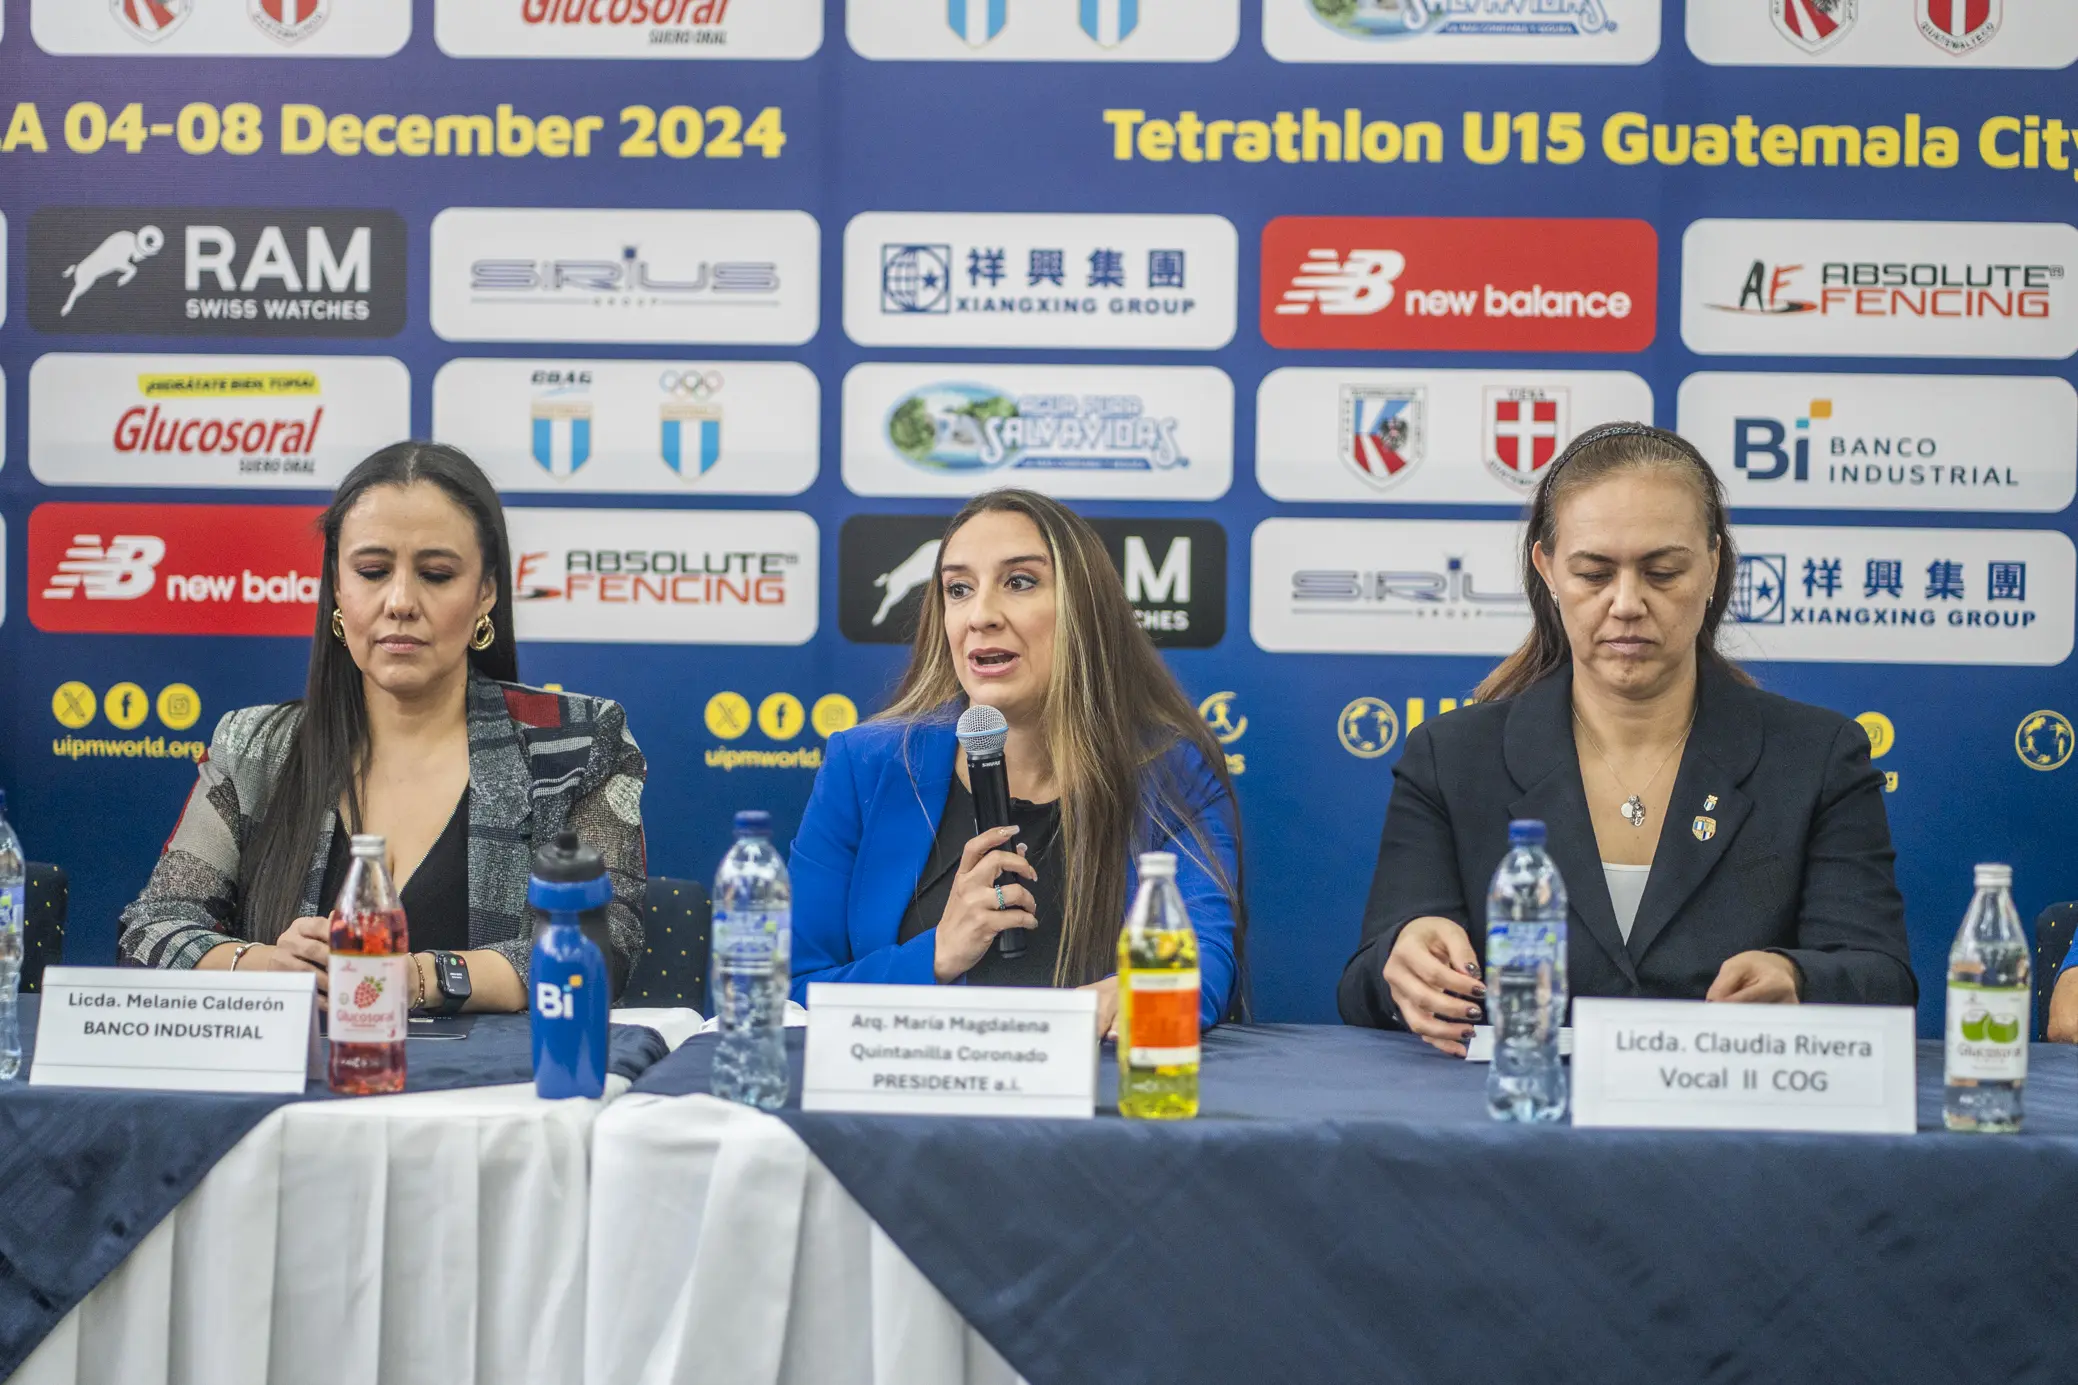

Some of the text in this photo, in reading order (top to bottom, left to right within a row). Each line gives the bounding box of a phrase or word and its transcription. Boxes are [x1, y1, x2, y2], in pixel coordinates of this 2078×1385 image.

[64, 102, 263, 154] 04-08
[281, 104, 603, 157] December
[620, 105, 786, 158] 2024
[1103, 108, 1443, 163] Tetrathlon
[1463, 112, 1584, 164] U15
[1602, 112, 1959, 168] Guatemala
[185, 226, 370, 292] RAM
[968, 249, 1184, 289] 祥興集團
[1821, 262, 2050, 288] ABSOLUTE
[185, 297, 370, 321] SWISS WATCHES
[956, 297, 1196, 315] XIANGXING GROUP
[1405, 284, 1631, 318] new balance
[1820, 288, 2050, 318] FENCING
[114, 405, 323, 454] Glucosoral
[1733, 416, 1811, 482] Bi
[1830, 437, 1937, 458] BANCO
[1829, 465, 2019, 486] INDUSTRIAL
[565, 550, 786, 574] ABSOLUTE
[167, 575, 236, 601] new
[564, 576, 786, 604] FENCING
[1803, 559, 2026, 601] 祥興集團
[1791, 607, 2036, 628] XIANGXING GROUP
[53, 735, 205, 761] uipmworld.org
[68, 992, 284, 1011] Licda. Melanie Calderón
[536, 981, 575, 1019] Bi
[83, 1020, 263, 1040] BANCO INDUSTRIAL
[851, 1014, 1050, 1036] Arq. María Magdalena
[849, 1042, 1049, 1064] Quintanilla Coronado
[1616, 1030, 1873, 1058] Licda. Claudia Rivera
[872, 1073, 988, 1092] PRESIDENTE
[1659, 1067, 1829, 1093] Vocal II COG
